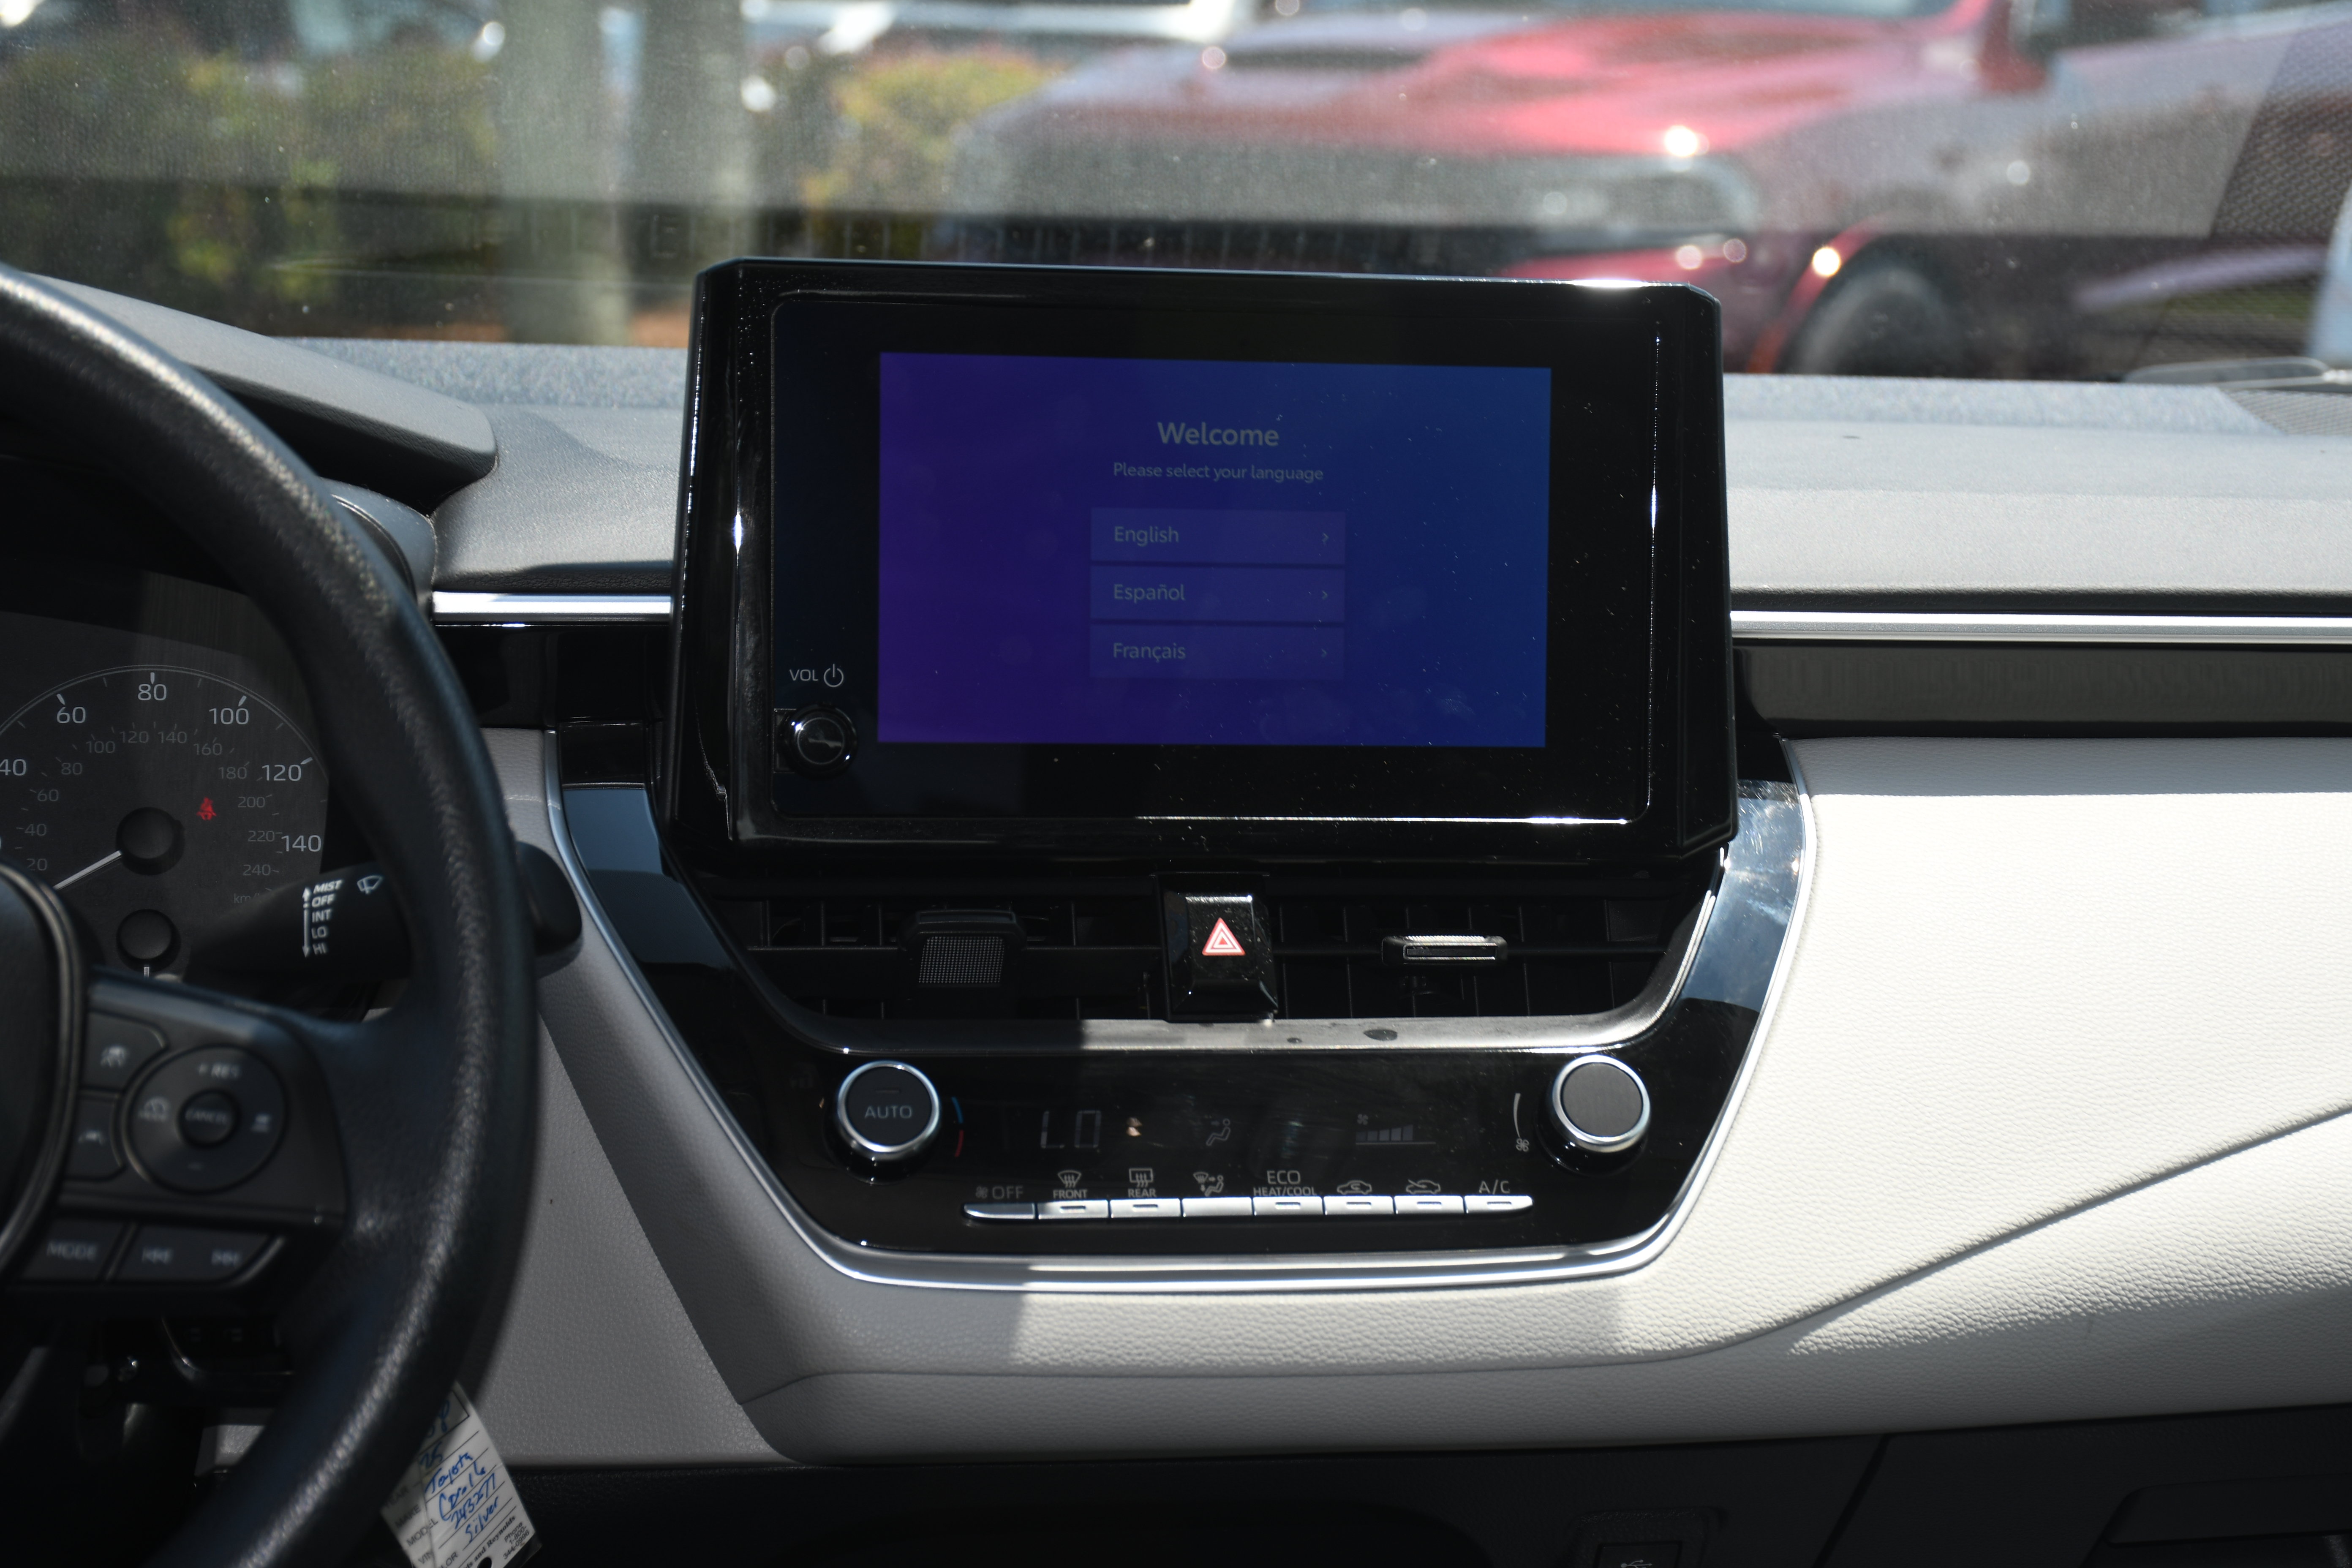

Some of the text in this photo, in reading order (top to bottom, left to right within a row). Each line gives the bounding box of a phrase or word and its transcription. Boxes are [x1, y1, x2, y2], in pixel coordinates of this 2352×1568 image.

[1157, 422, 1279, 446] Welcome
[1113, 462, 1324, 483] Please select your language
[1114, 526, 1179, 546] English
[1113, 584, 1186, 604] Español
[1113, 642, 1186, 662] Français
[789, 669, 818, 681] VOL
[137, 684, 167, 701] 80
[56, 707, 86, 724] 60
[209, 708, 249, 725] 100
[120, 731, 149, 743] 120
[158, 732, 187, 744] 140
[86, 741, 115, 754] 100
[193, 743, 223, 756] 160
[0, 759, 27, 776] 40
[61, 762, 82, 775] 80
[218, 767, 248, 779] 180
[261, 765, 302, 781] 120
[37, 789, 59, 802] 60
[237, 796, 266, 808] 200
[24, 823, 47, 836] 40
[248, 830, 275, 842] 220
[281, 835, 322, 852] 140
[26, 858, 47, 871] 20
[243, 864, 271, 876] 240
[313, 879, 344, 894] MIST
[312, 893, 336, 908] OFF
[312, 908, 334, 923] INT
[312, 926, 329, 939] LO
[312, 942, 329, 956] HI
[864, 1105, 912, 1119] AUTO
[1267, 1171, 1301, 1184] ECO
[992, 1187, 1024, 1200] OFF
[1053, 1189, 1088, 1198] FRONT
[1127, 1188, 1156, 1198] REAR
[1253, 1187, 1318, 1197] HEAT/COOL
[1478, 1180, 1511, 1194] A/C
[46, 1241, 99, 1262] MODE
[395, 1504, 421, 1527] MAKE
[465, 1496, 498, 1544] Silver
[406, 1519, 438, 1546] MODEL
[474, 1516, 515, 1562] and Reynolds
[504, 1522, 523, 1543] Phone
[509, 1526, 527, 1545] 1-800-
[503, 1530, 530, 1560] 344-0996
